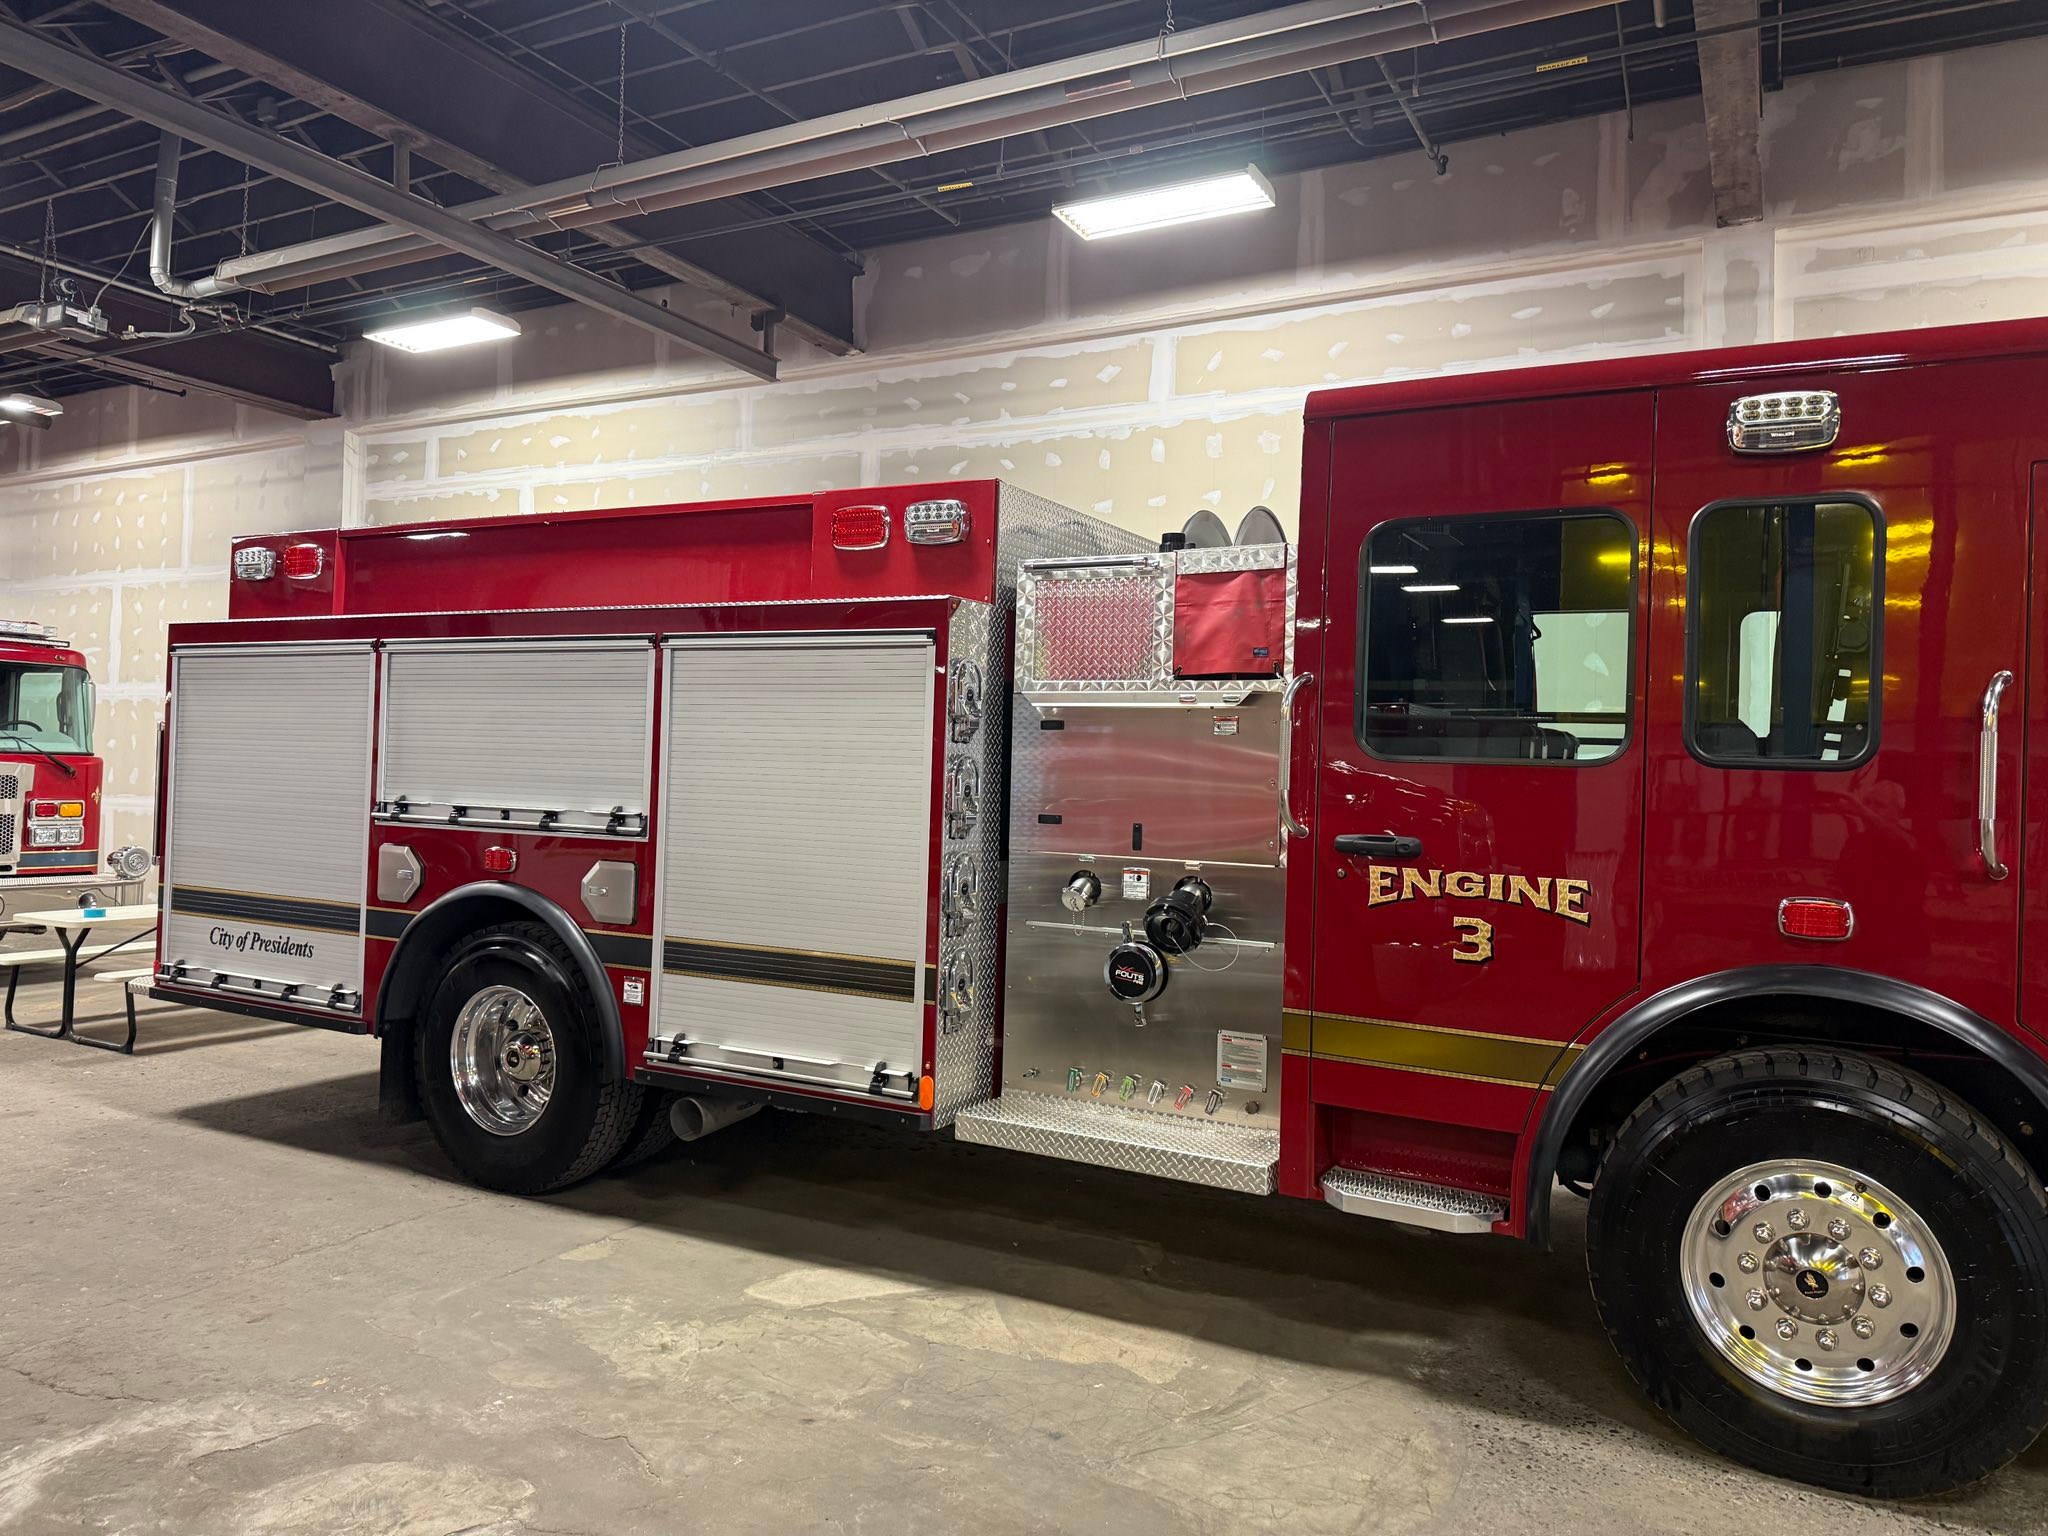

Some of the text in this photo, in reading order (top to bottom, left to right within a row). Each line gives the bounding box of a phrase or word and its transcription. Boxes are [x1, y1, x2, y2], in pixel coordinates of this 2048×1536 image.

[1367, 865, 1591, 926] ENGINE
[209, 926, 315, 959] City of Presidents
[1453, 916, 1493, 962] 3
[1115, 969, 1145, 981] FOUTS
